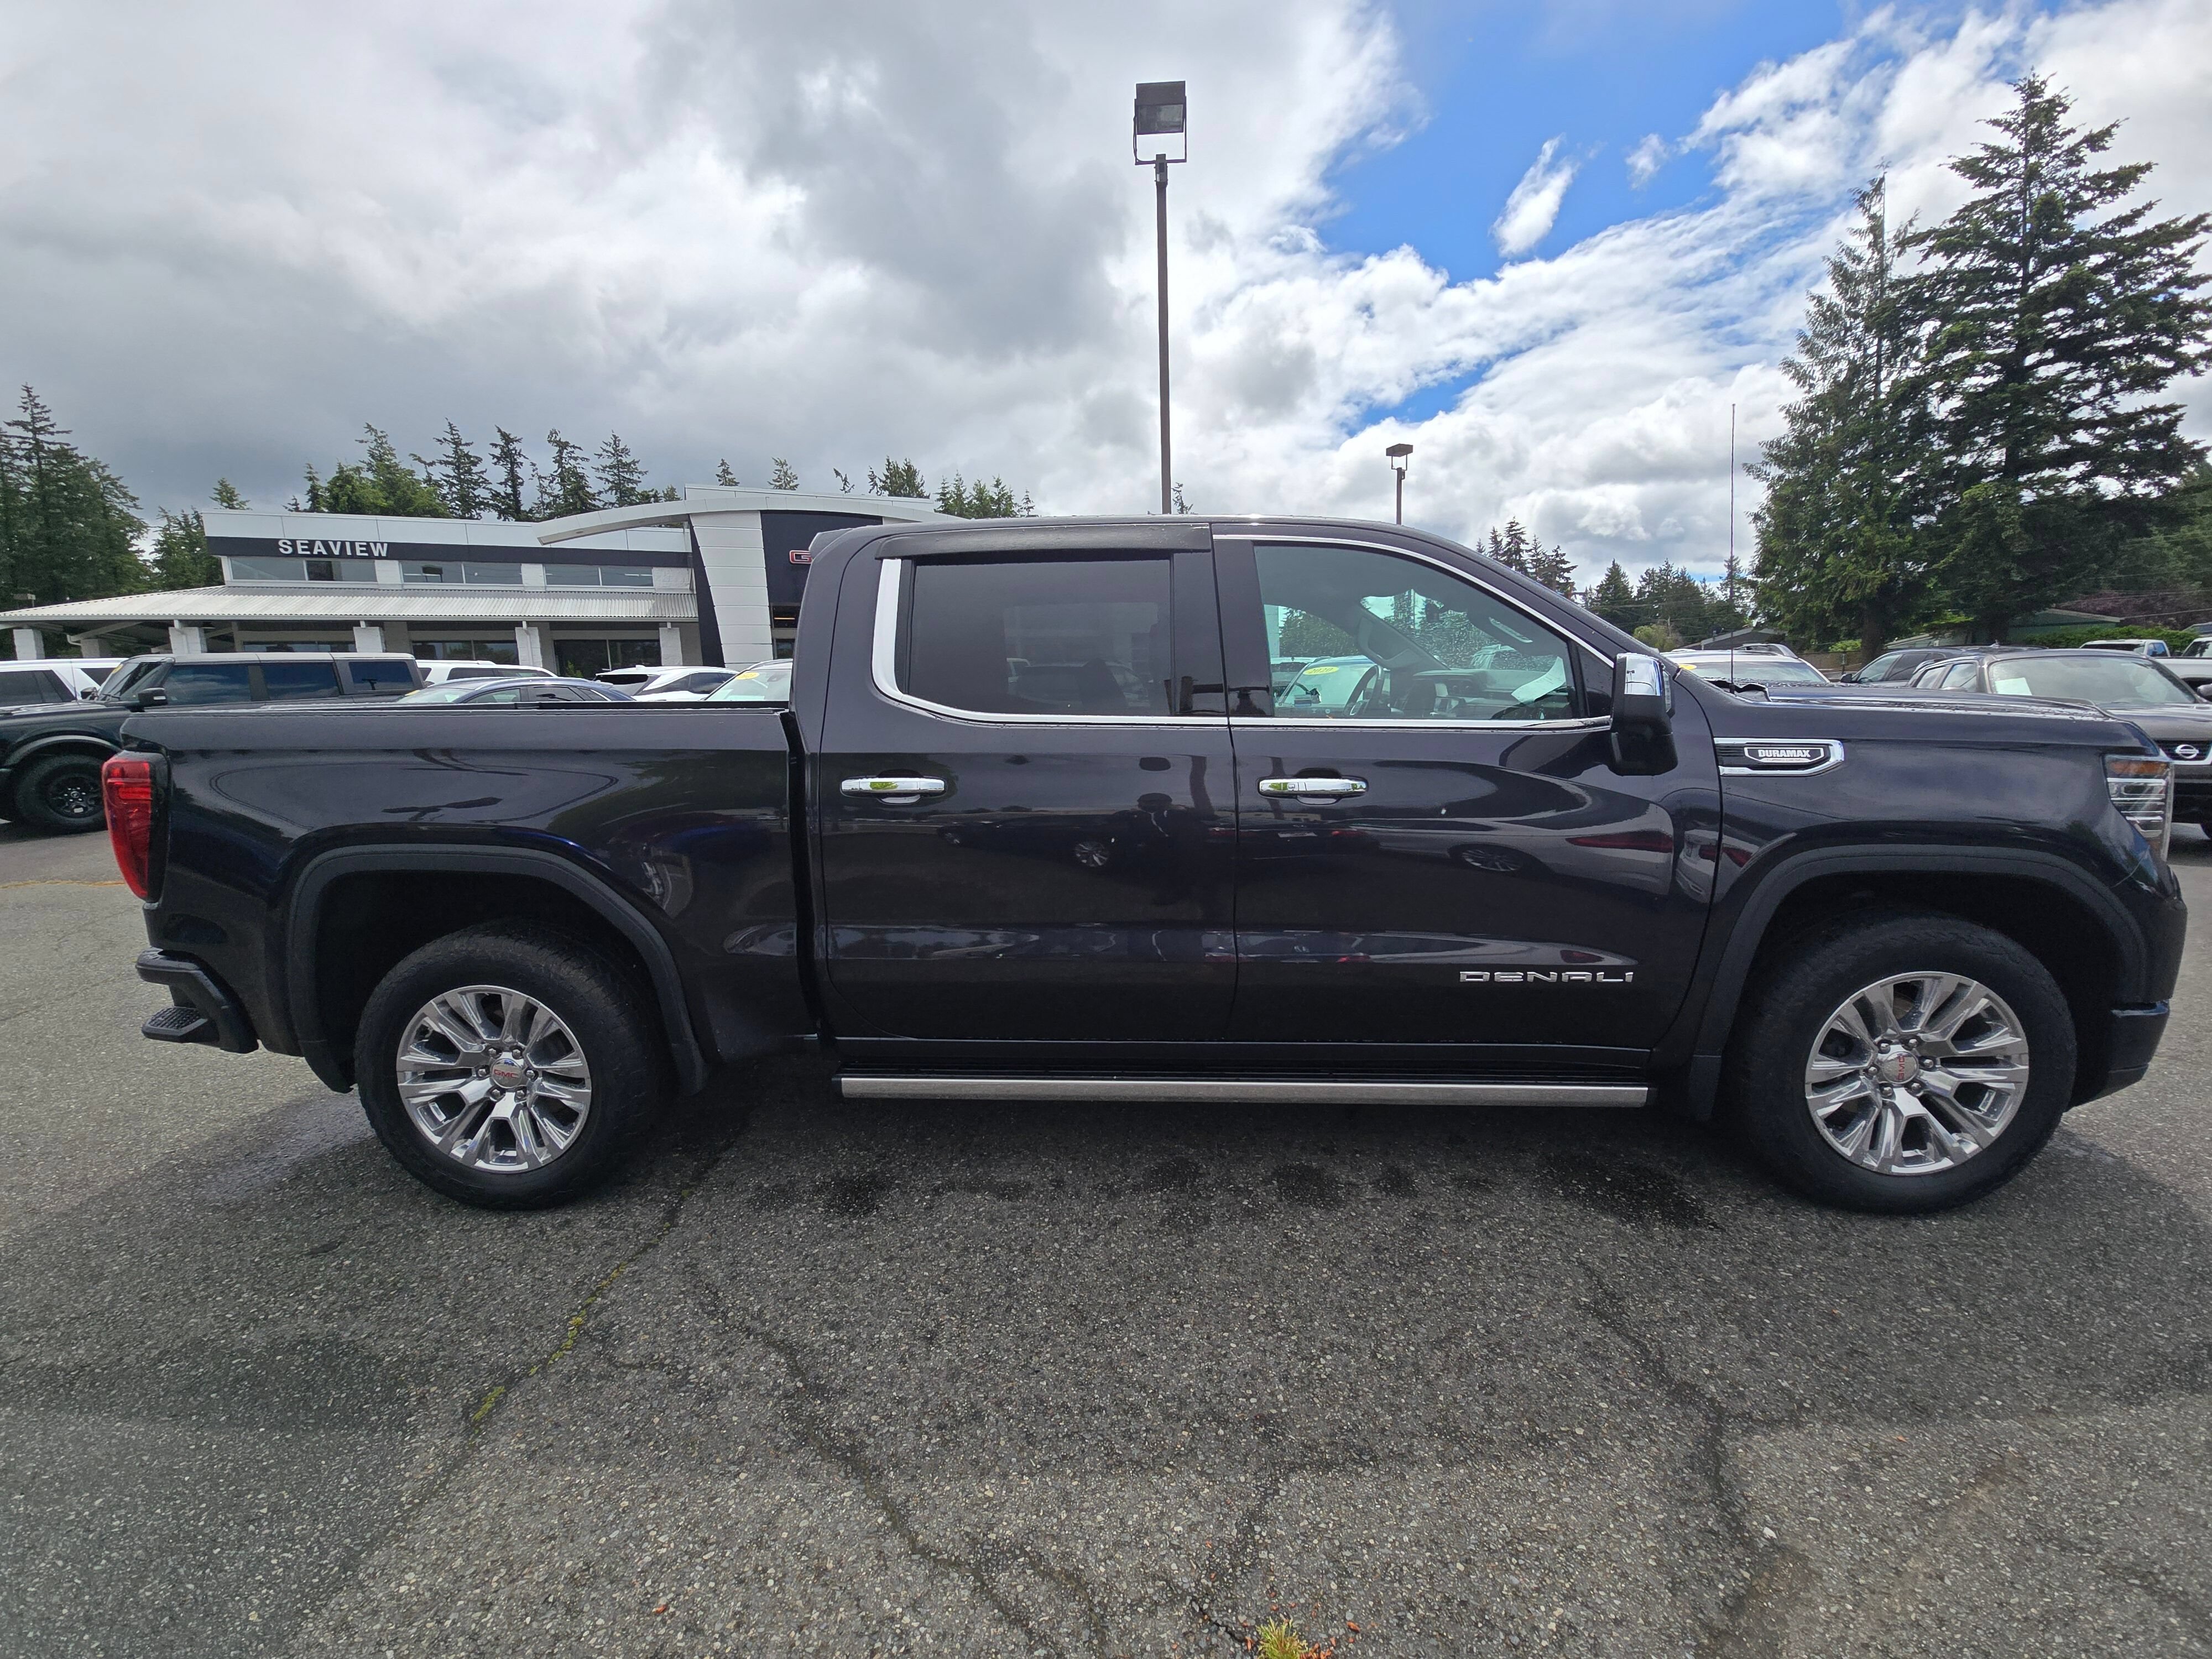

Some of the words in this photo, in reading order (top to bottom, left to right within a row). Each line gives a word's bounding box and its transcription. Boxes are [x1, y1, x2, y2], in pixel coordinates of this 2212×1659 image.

[278, 539, 388, 557] SEAVIEW
[1460, 972, 1634, 982] DENALI
[494, 1069, 518, 1078] GMC
